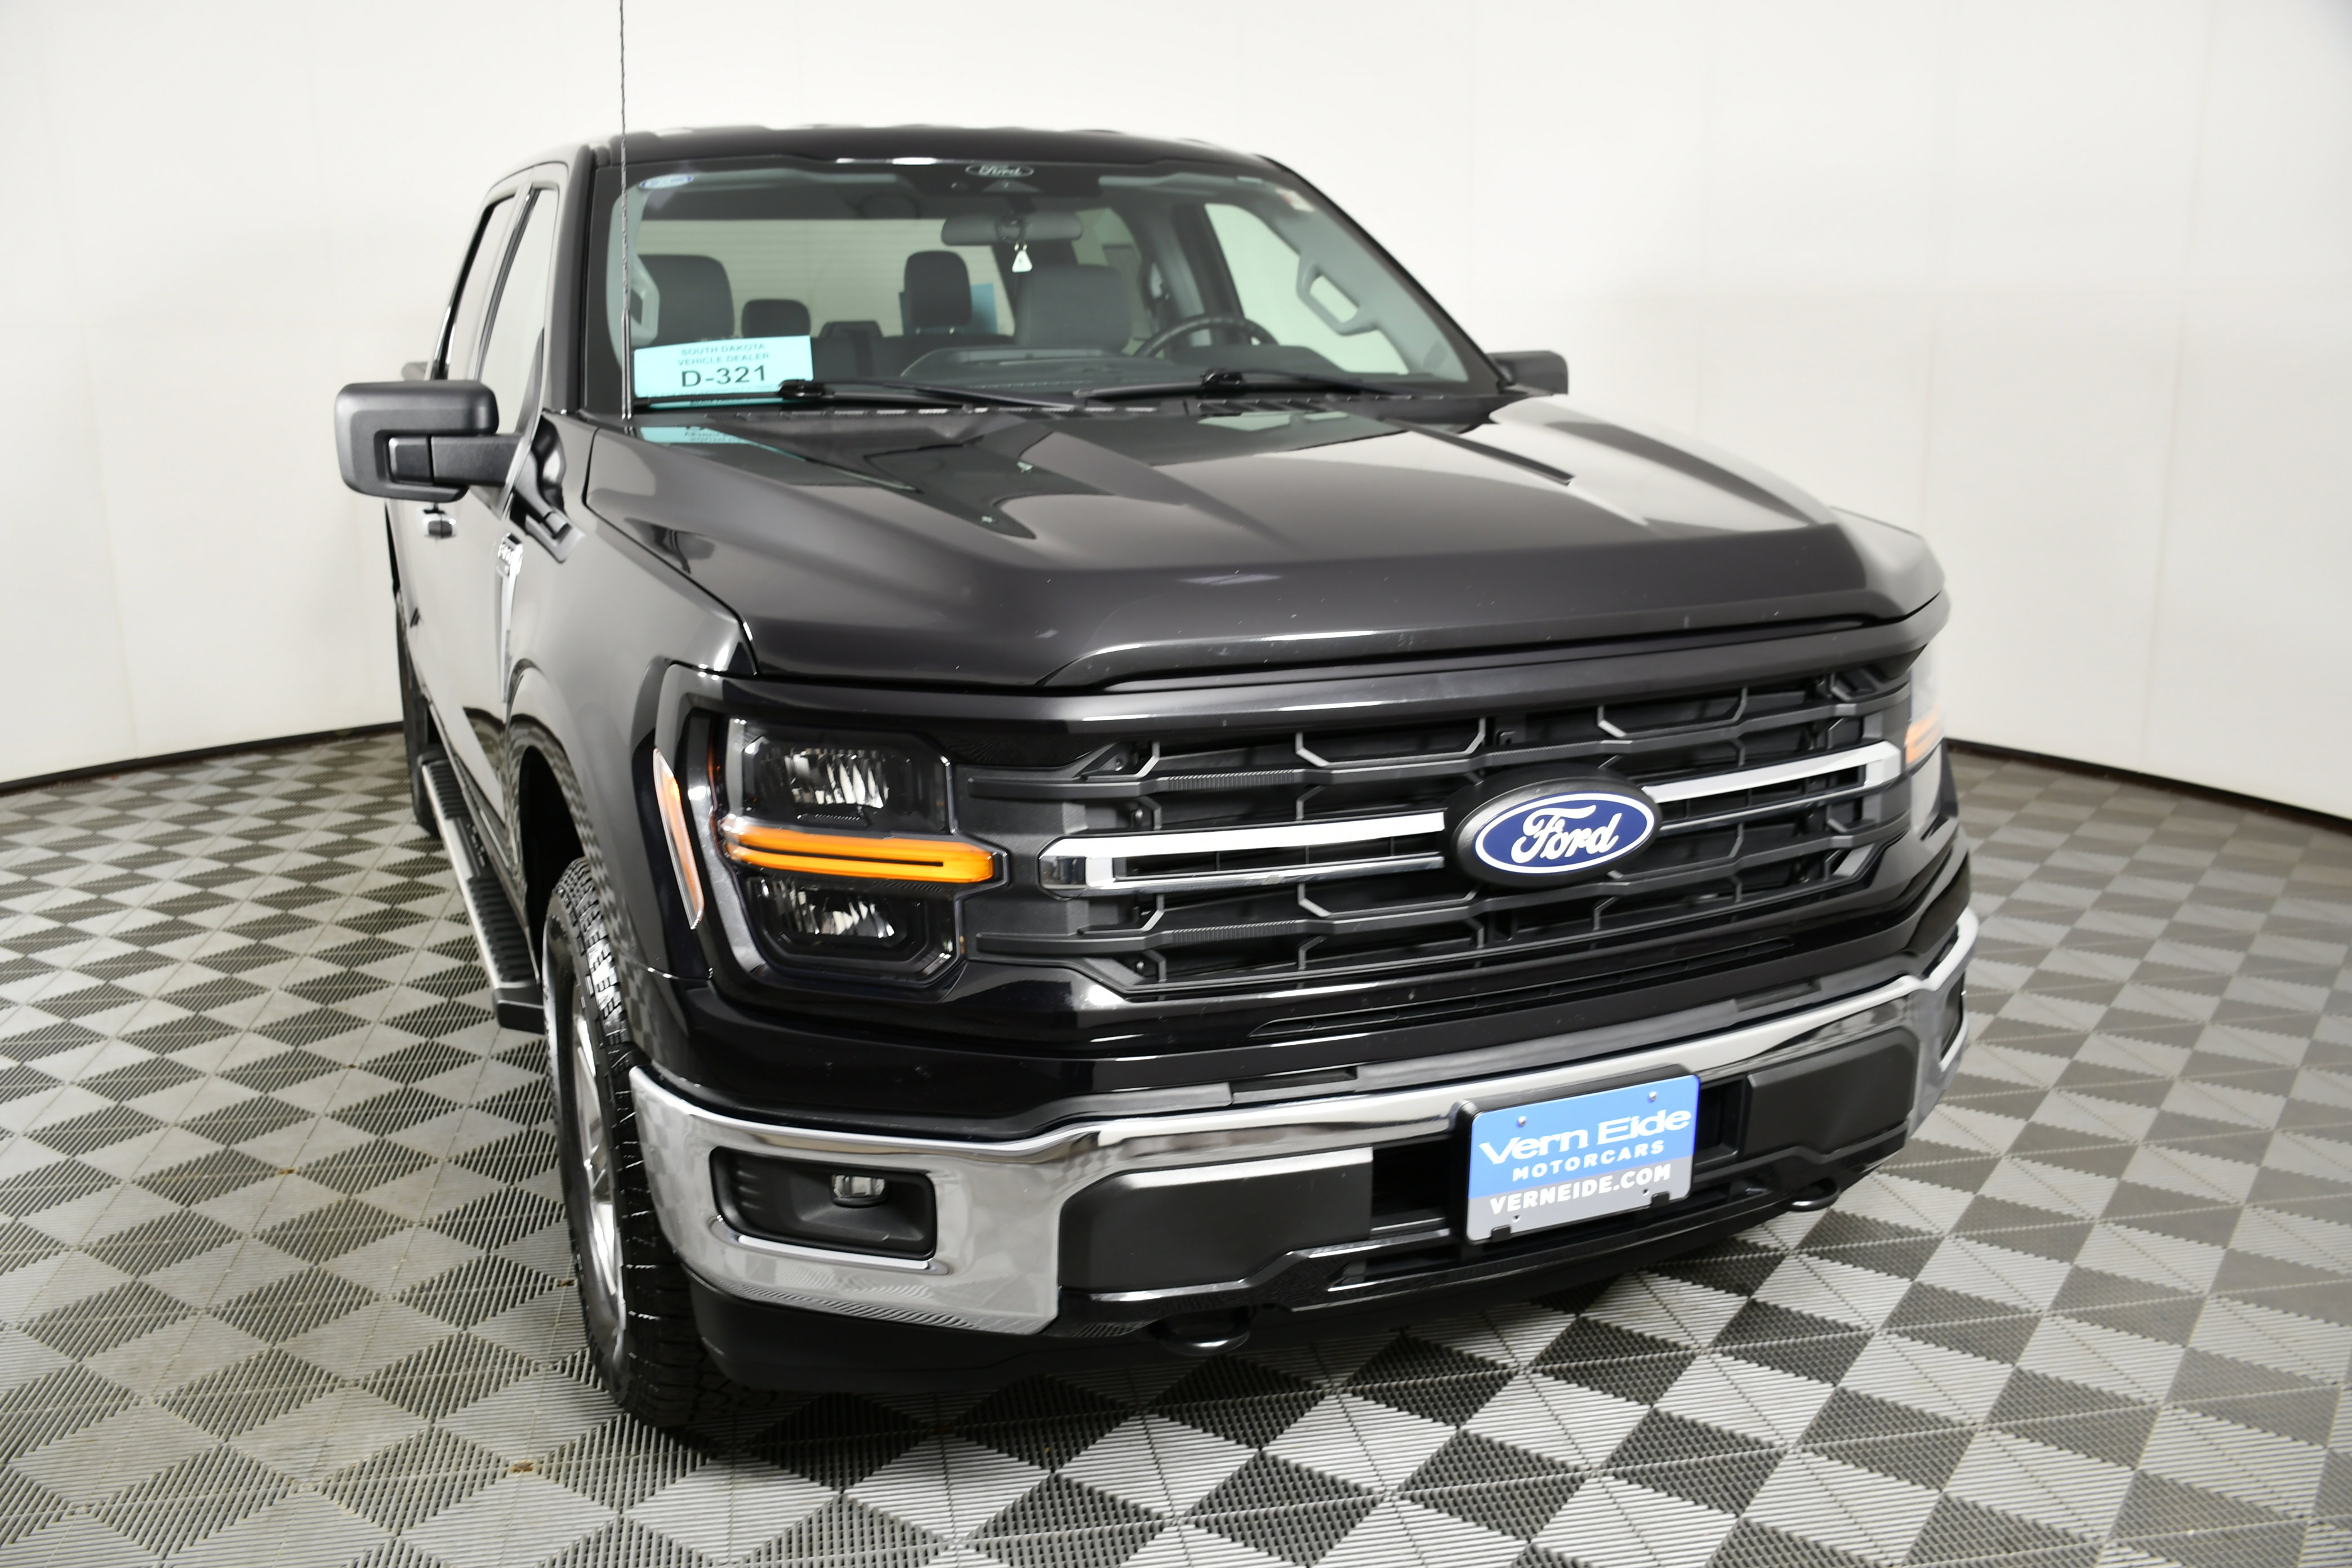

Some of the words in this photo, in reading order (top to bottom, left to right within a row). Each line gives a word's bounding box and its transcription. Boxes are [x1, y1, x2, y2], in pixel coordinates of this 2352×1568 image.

[678, 355, 721, 366] VEHICLE
[727, 353, 769, 362] DEALER
[681, 347, 718, 356] SOUTH
[721, 344, 765, 353] DAKOTA
[681, 365, 765, 387] D-321
[1511, 805, 1622, 863] Ford
[1478, 1128, 1588, 1165] Vern
[1597, 1109, 1691, 1145] Eide
[1512, 1140, 1664, 1182] MOTORCARS
[1490, 1163, 1671, 1214] VERNEIDE.COM
